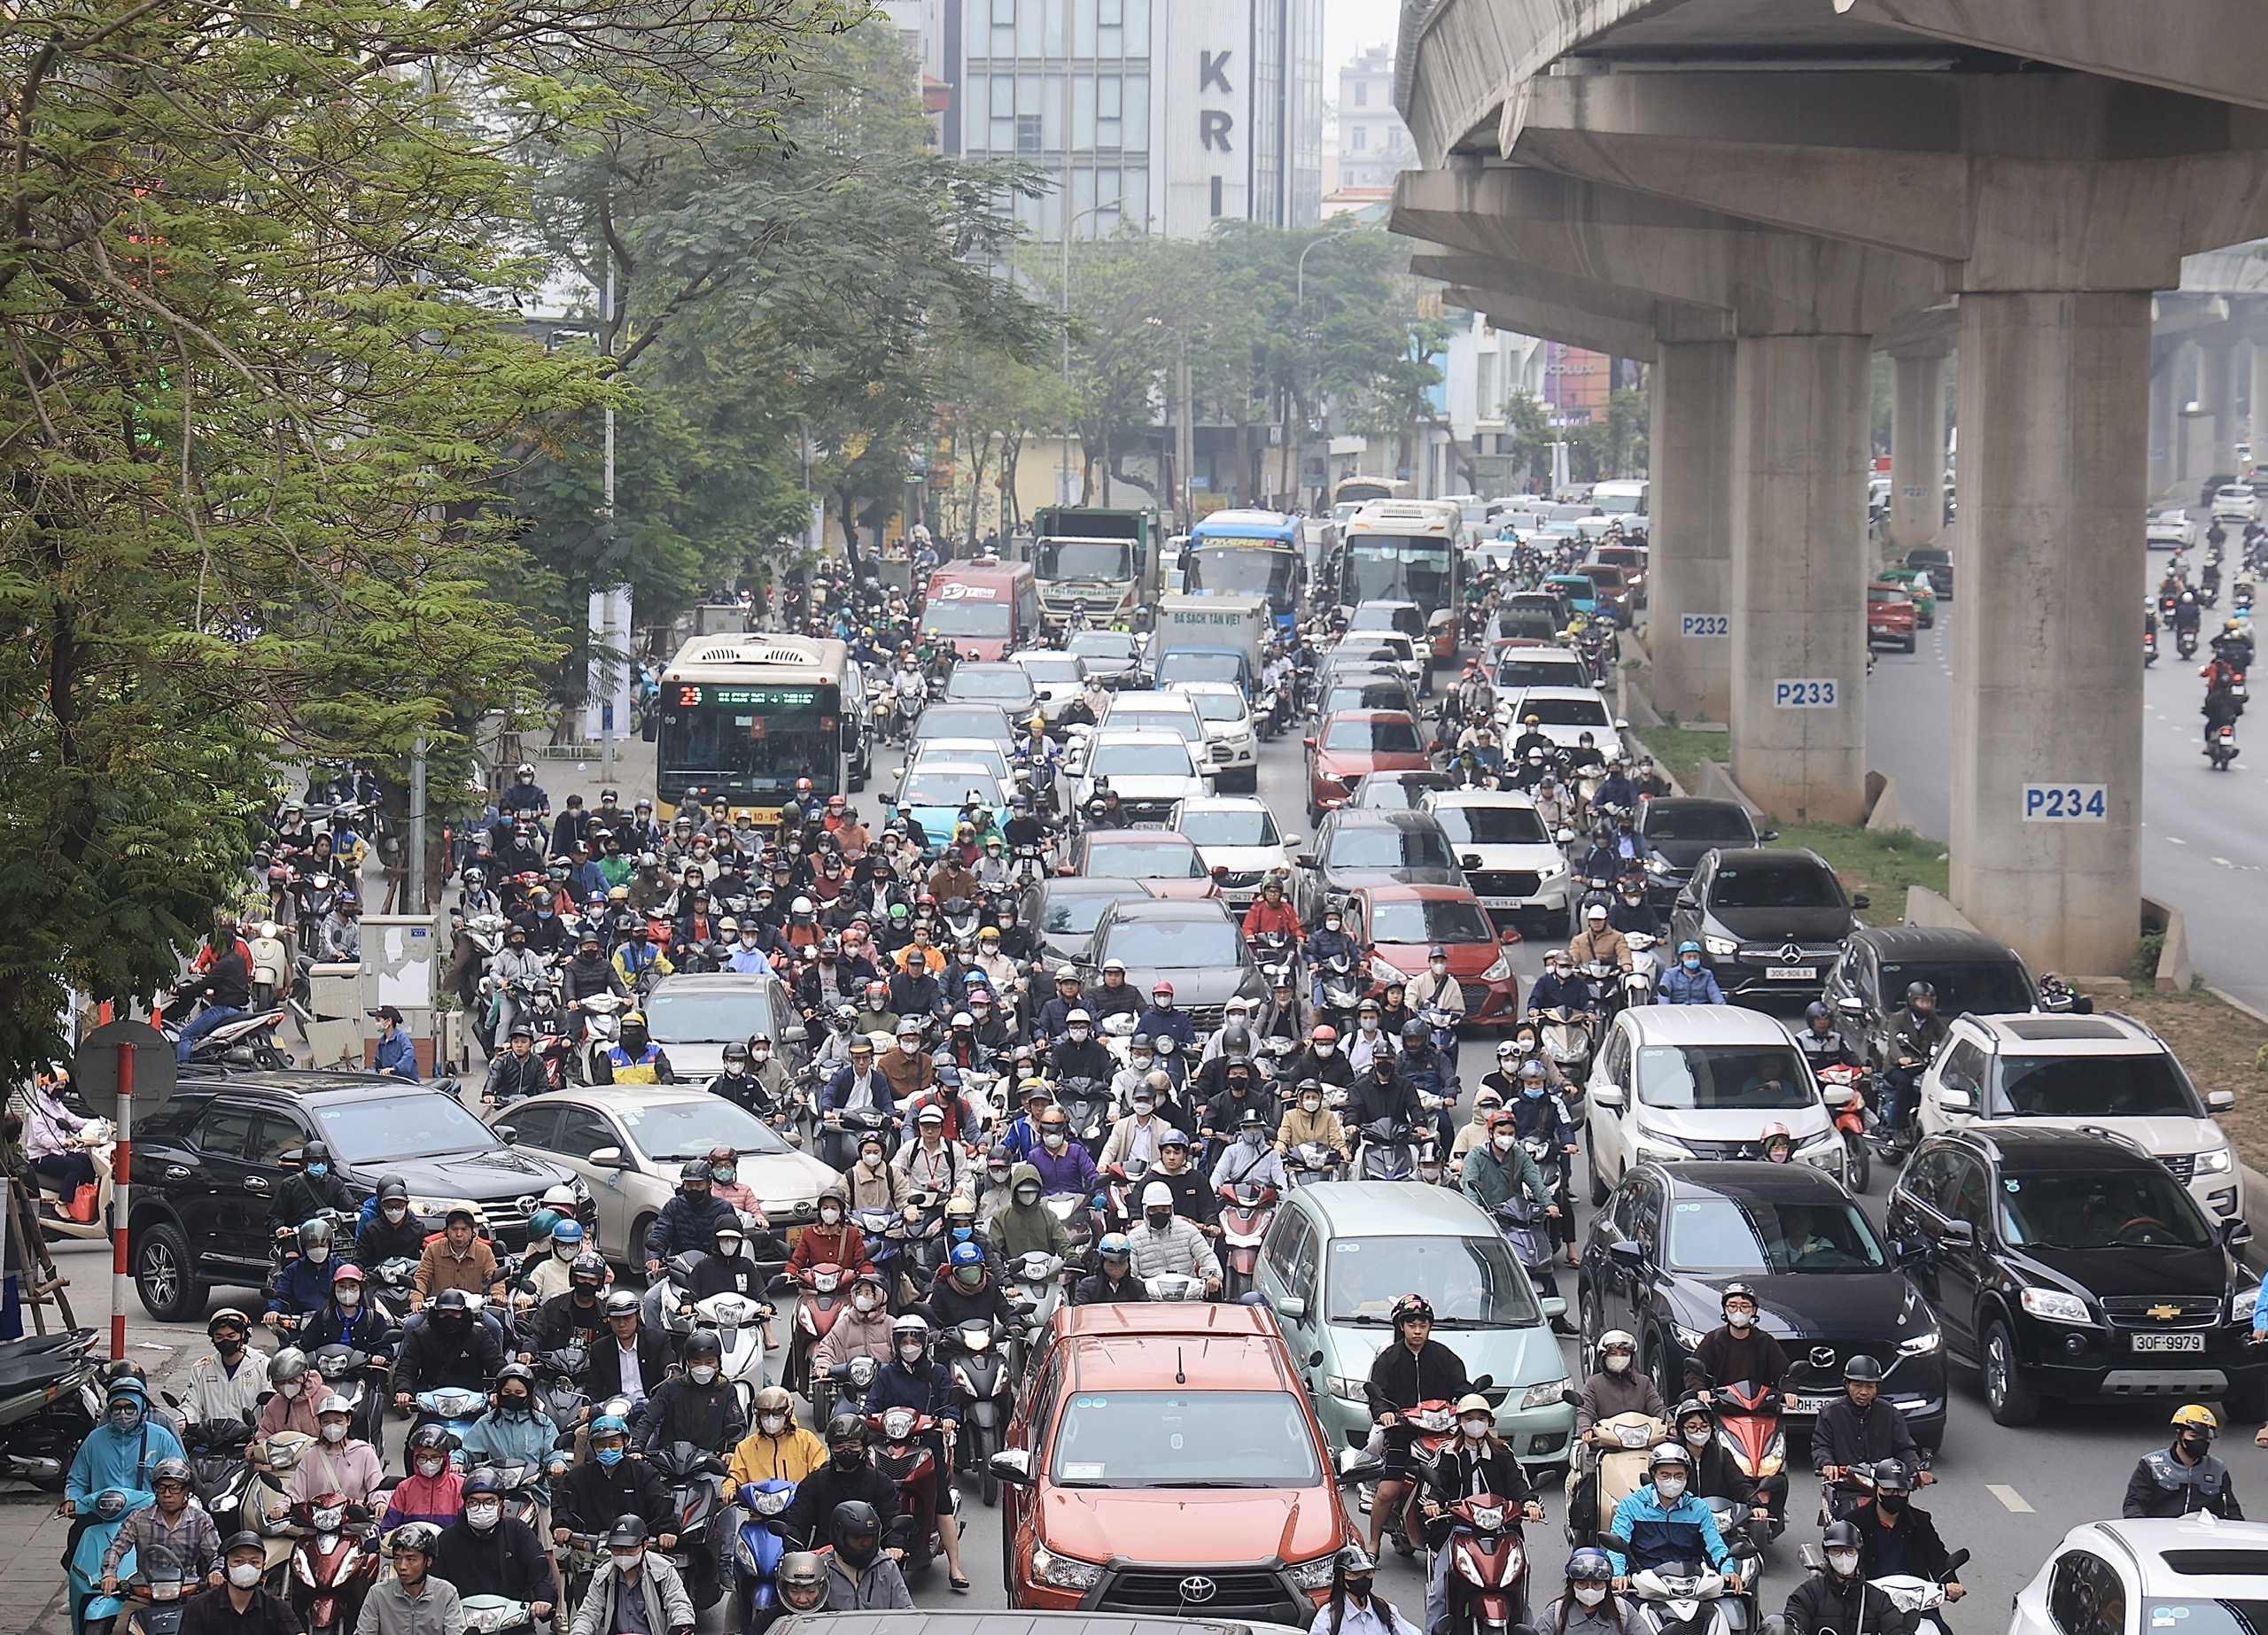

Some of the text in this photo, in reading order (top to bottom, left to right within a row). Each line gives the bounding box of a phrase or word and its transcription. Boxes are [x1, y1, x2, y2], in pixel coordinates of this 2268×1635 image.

[1682, 616, 1728, 636] P232
[1776, 683, 1835, 705] P233
[2027, 789, 2106, 817] P234
[2136, 1336, 2201, 1350] 30F-9979
